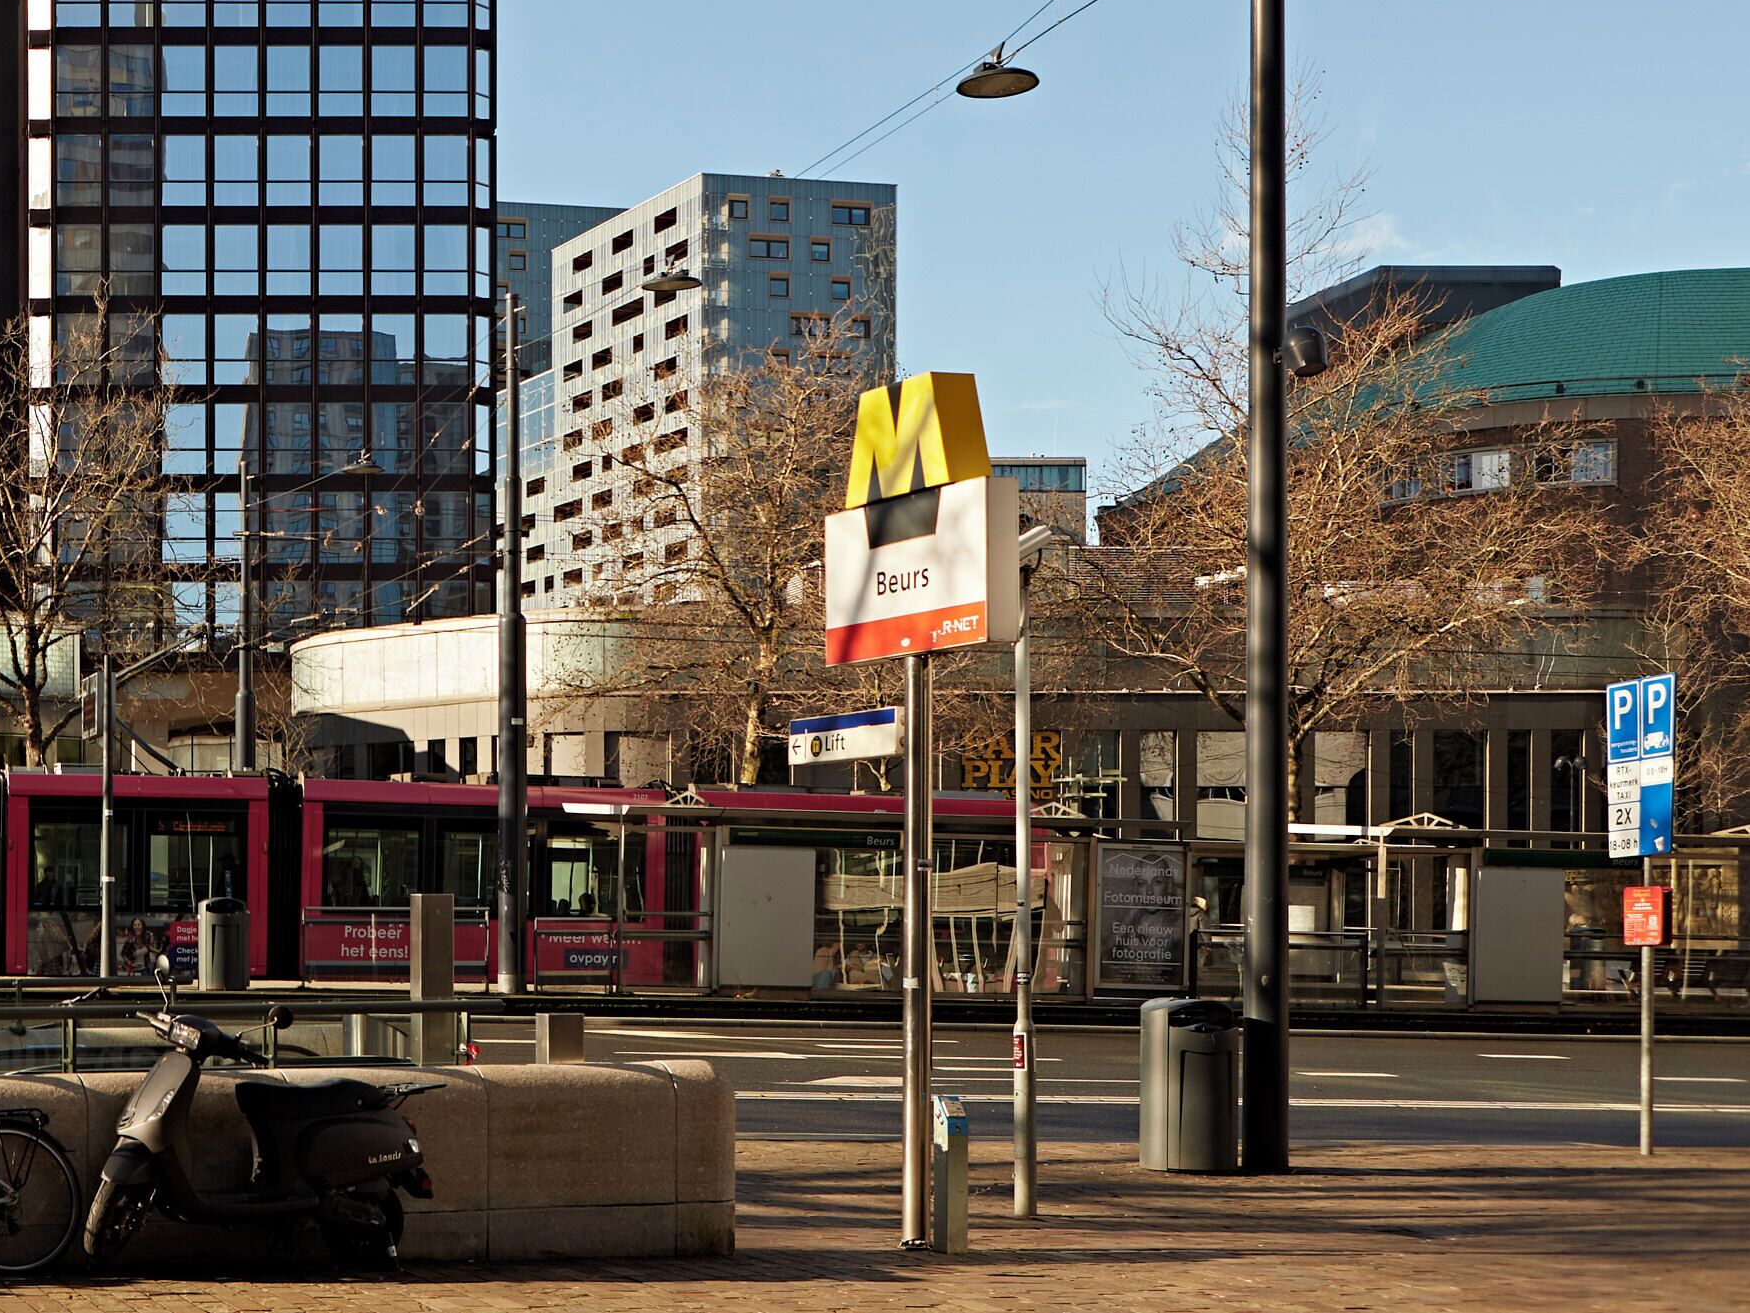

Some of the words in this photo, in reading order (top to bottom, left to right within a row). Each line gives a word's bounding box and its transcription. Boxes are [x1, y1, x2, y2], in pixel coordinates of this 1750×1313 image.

[876, 567, 930, 596] Beurs
[1614, 689, 1633, 730] P
[1647, 682, 1667, 725] P
[825, 733, 845, 752] Lift
[1609, 777, 1639, 789] keurmerk
[632, 793, 649, 801] 2107
[1616, 791, 1632, 801] TAXI
[1615, 807, 1632, 826] 2X
[866, 835, 896, 847] Beurs
[1609, 838, 1631, 851] 18-08
[1109, 863, 1180, 877] Nederlands
[1104, 890, 1183, 905] Fotomuseum
[176, 926, 197, 934] Dagje
[344, 925, 403, 939] Probeer
[1112, 921, 1135, 934] Een
[1137, 924, 1173, 935] nieuw
[1115, 935, 1139, 947] huis
[1141, 937, 1169, 948] voor
[340, 943, 365, 957] het
[368, 944, 409, 959] eens!
[1112, 947, 1172, 962] fotografie
